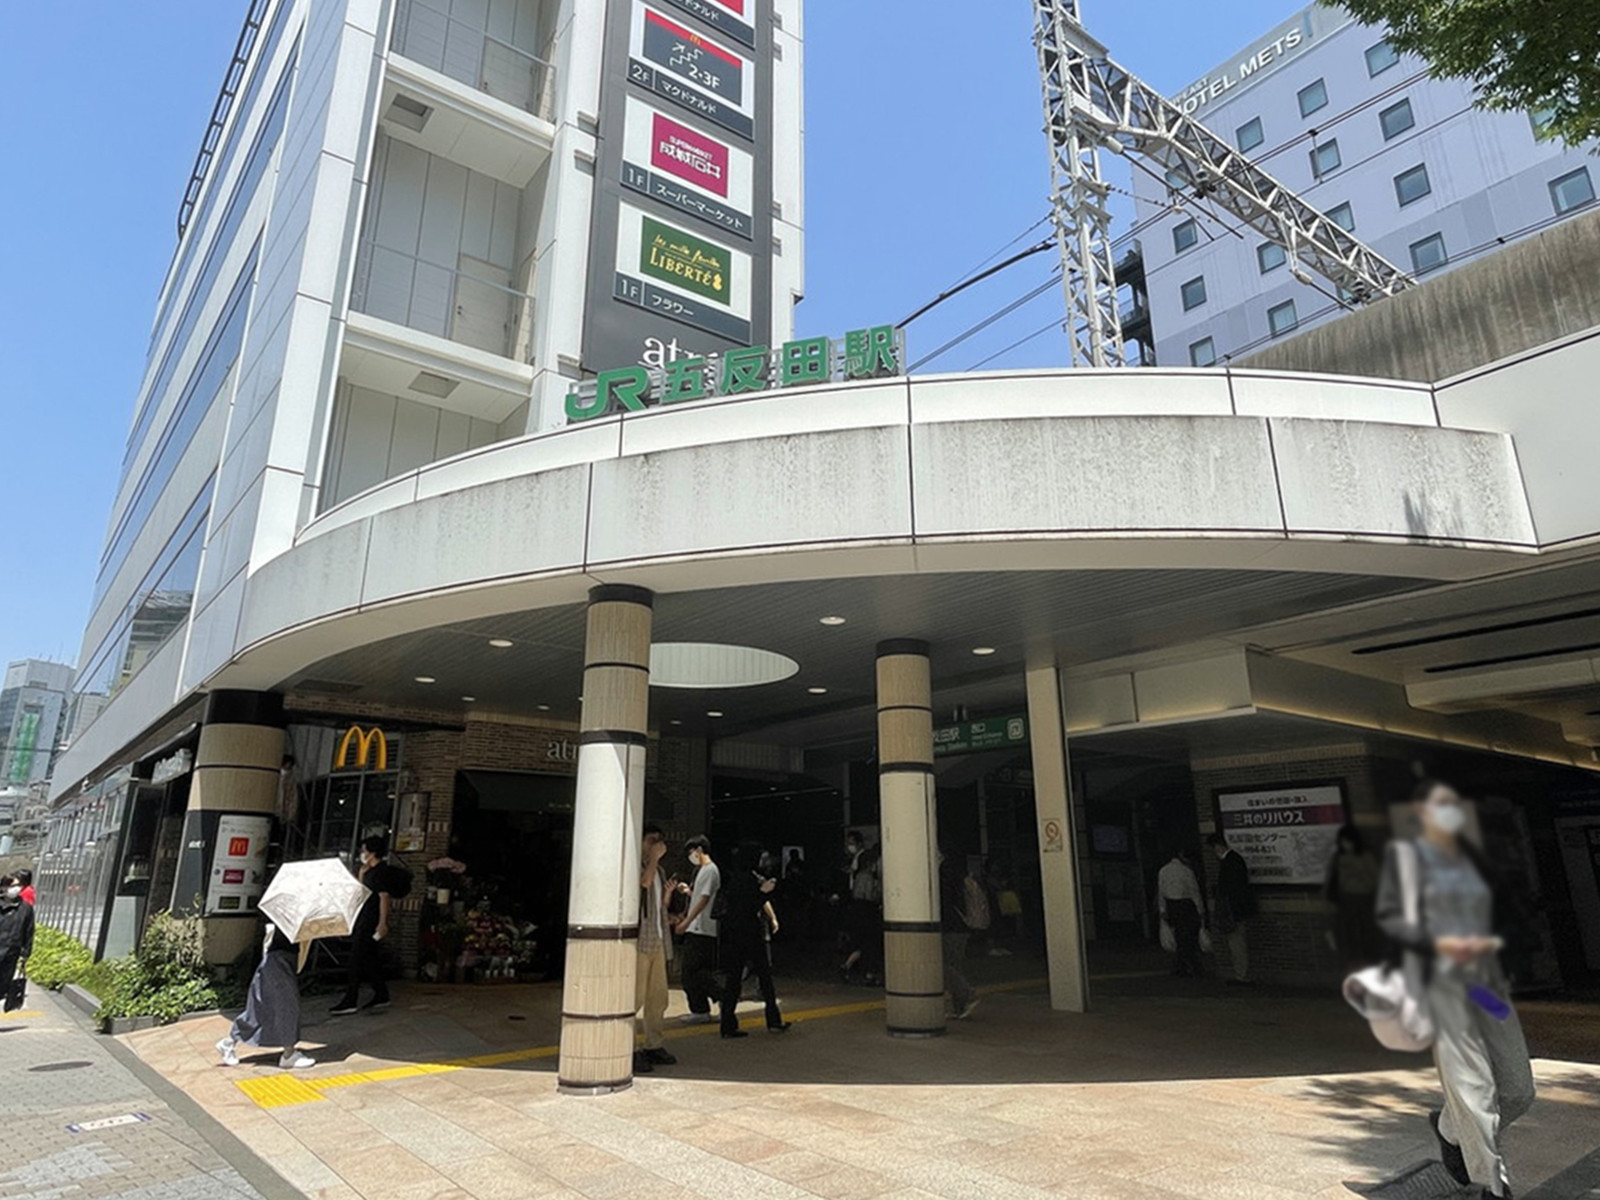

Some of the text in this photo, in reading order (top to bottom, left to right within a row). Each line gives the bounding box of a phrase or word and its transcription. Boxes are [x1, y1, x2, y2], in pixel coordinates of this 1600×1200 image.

[1239, 27, 1302, 78] METS
[632, 64, 650, 82] 2F
[661, 82, 718, 114] マクドナルド
[659, 141, 721, 179] 成城石井
[669, 135, 713, 160] SUPERMARKET
[628, 168, 644, 186] 1F
[657, 183, 743, 228] スーパーマーケット
[650, 247, 712, 286] LIBERTÉ
[621, 279, 639, 298] 1F
[652, 294, 694, 316] フラワー
